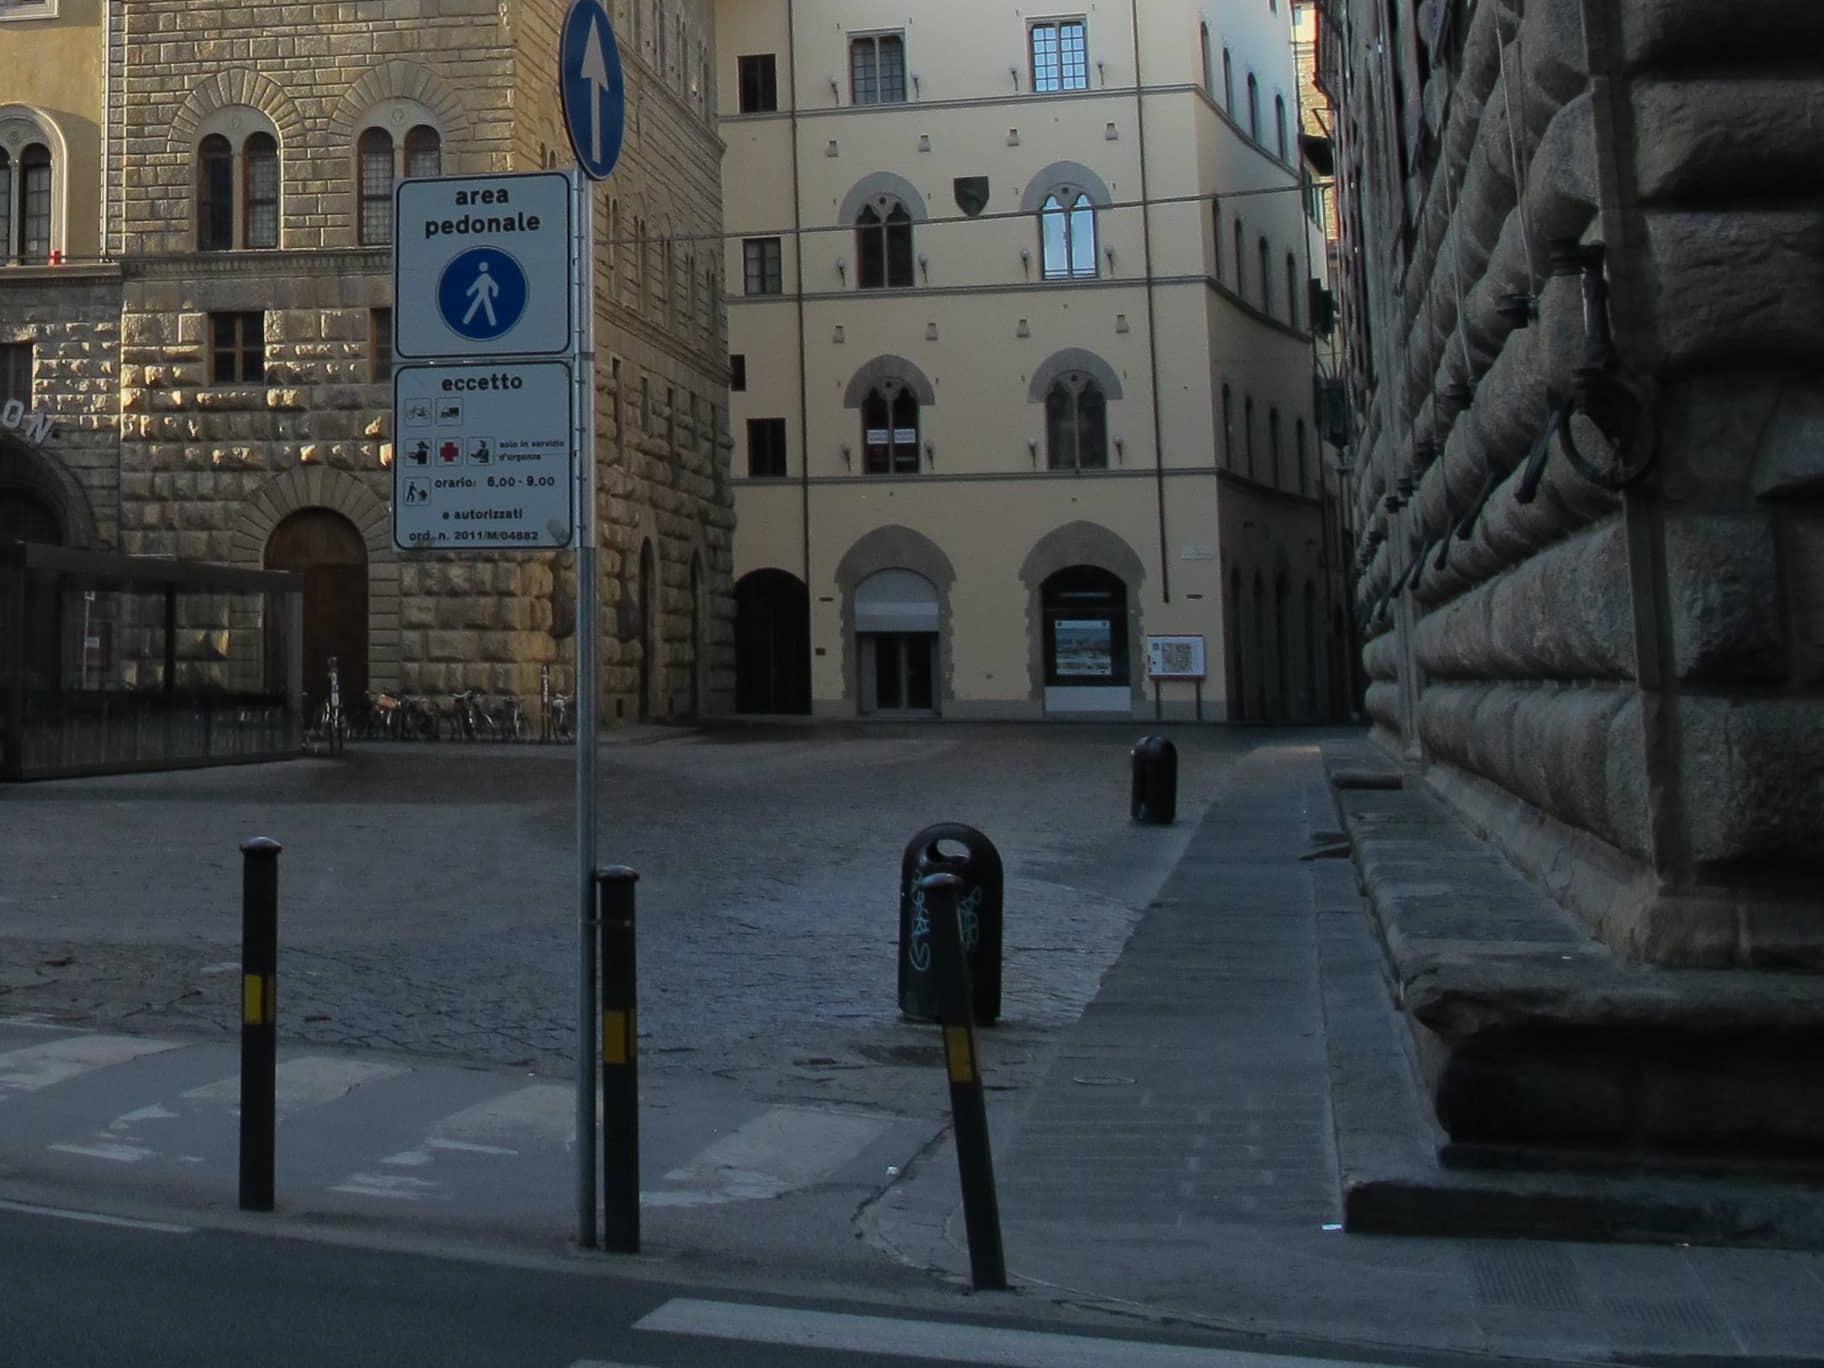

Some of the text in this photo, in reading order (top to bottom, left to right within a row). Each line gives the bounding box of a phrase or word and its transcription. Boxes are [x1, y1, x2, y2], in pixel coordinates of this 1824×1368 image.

[455, 188, 509, 206] area
[425, 212, 541, 239] pedonale
[441, 373, 523, 392] eccetto
[487, 476, 516, 489] 6.00
[526, 475, 556, 488] 9.00
[442, 507, 523, 521] e autorizzati
